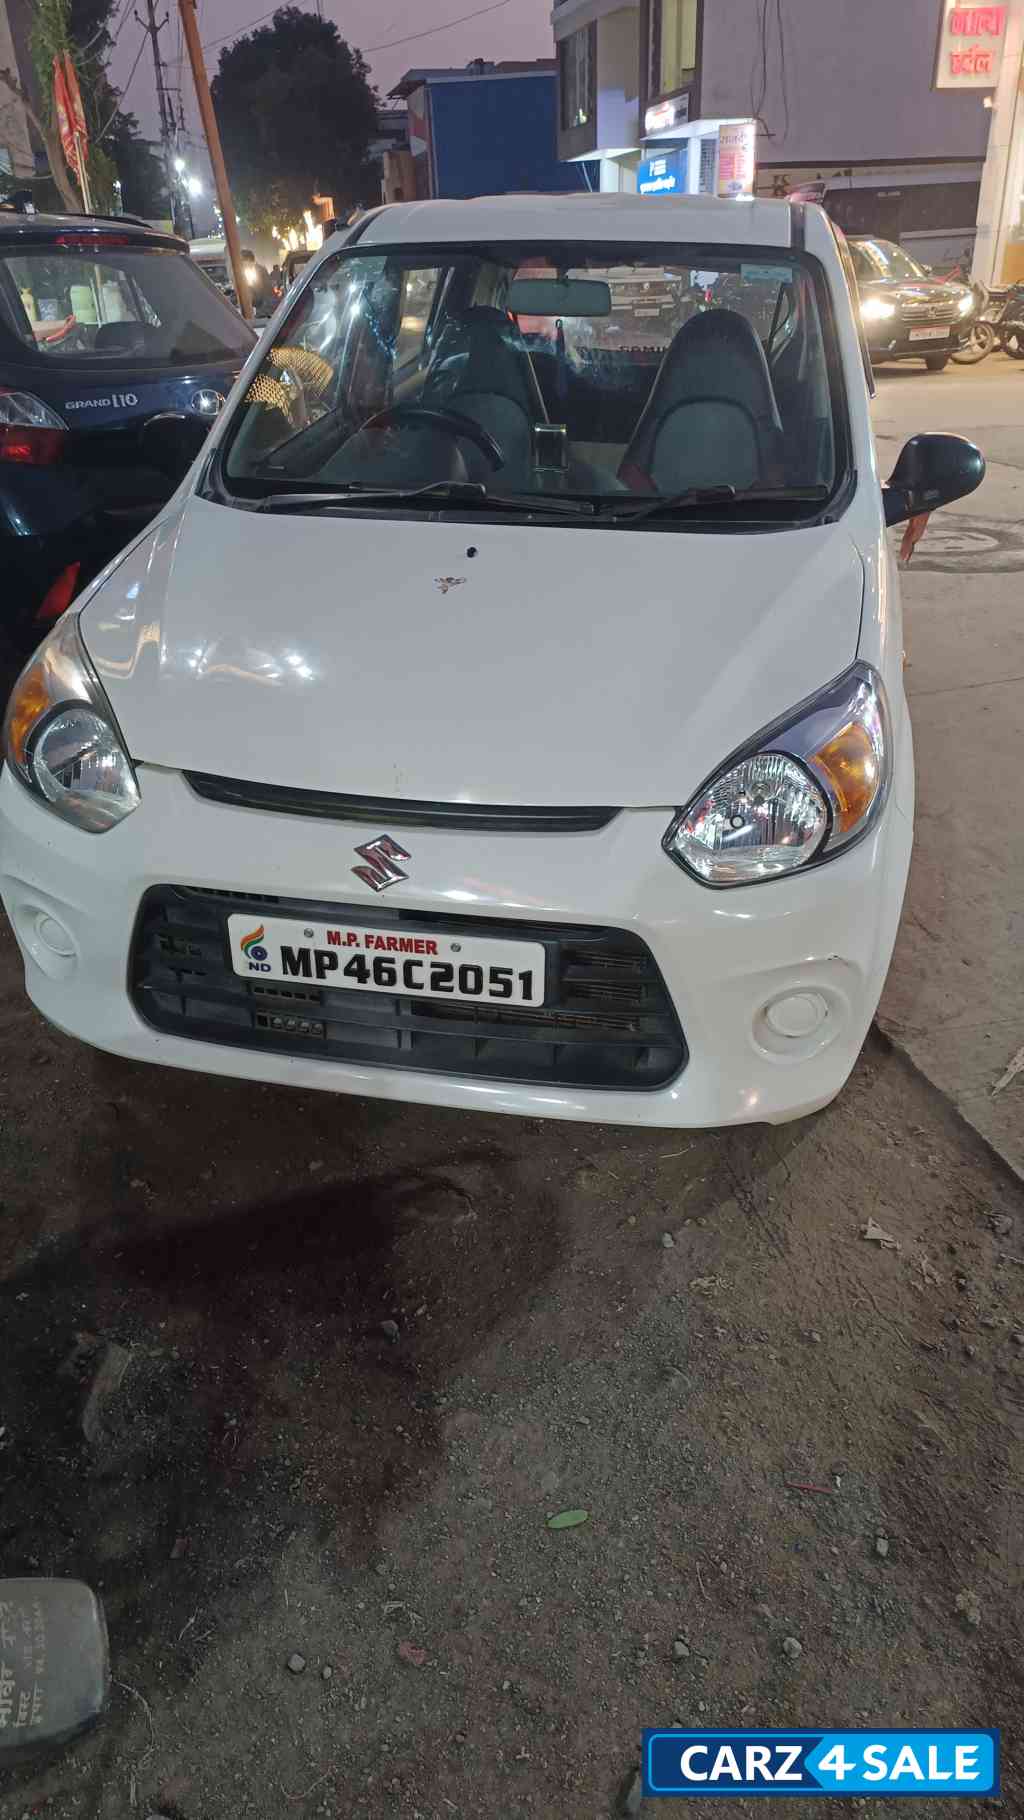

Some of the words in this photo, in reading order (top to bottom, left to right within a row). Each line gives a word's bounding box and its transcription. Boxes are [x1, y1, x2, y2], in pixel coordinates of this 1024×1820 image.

[65, 399, 111, 410] GRAND
[326, 930, 361, 948] M.P.
[364, 934, 439, 955] FARMER
[280, 945, 533, 1001] MP46C2051
